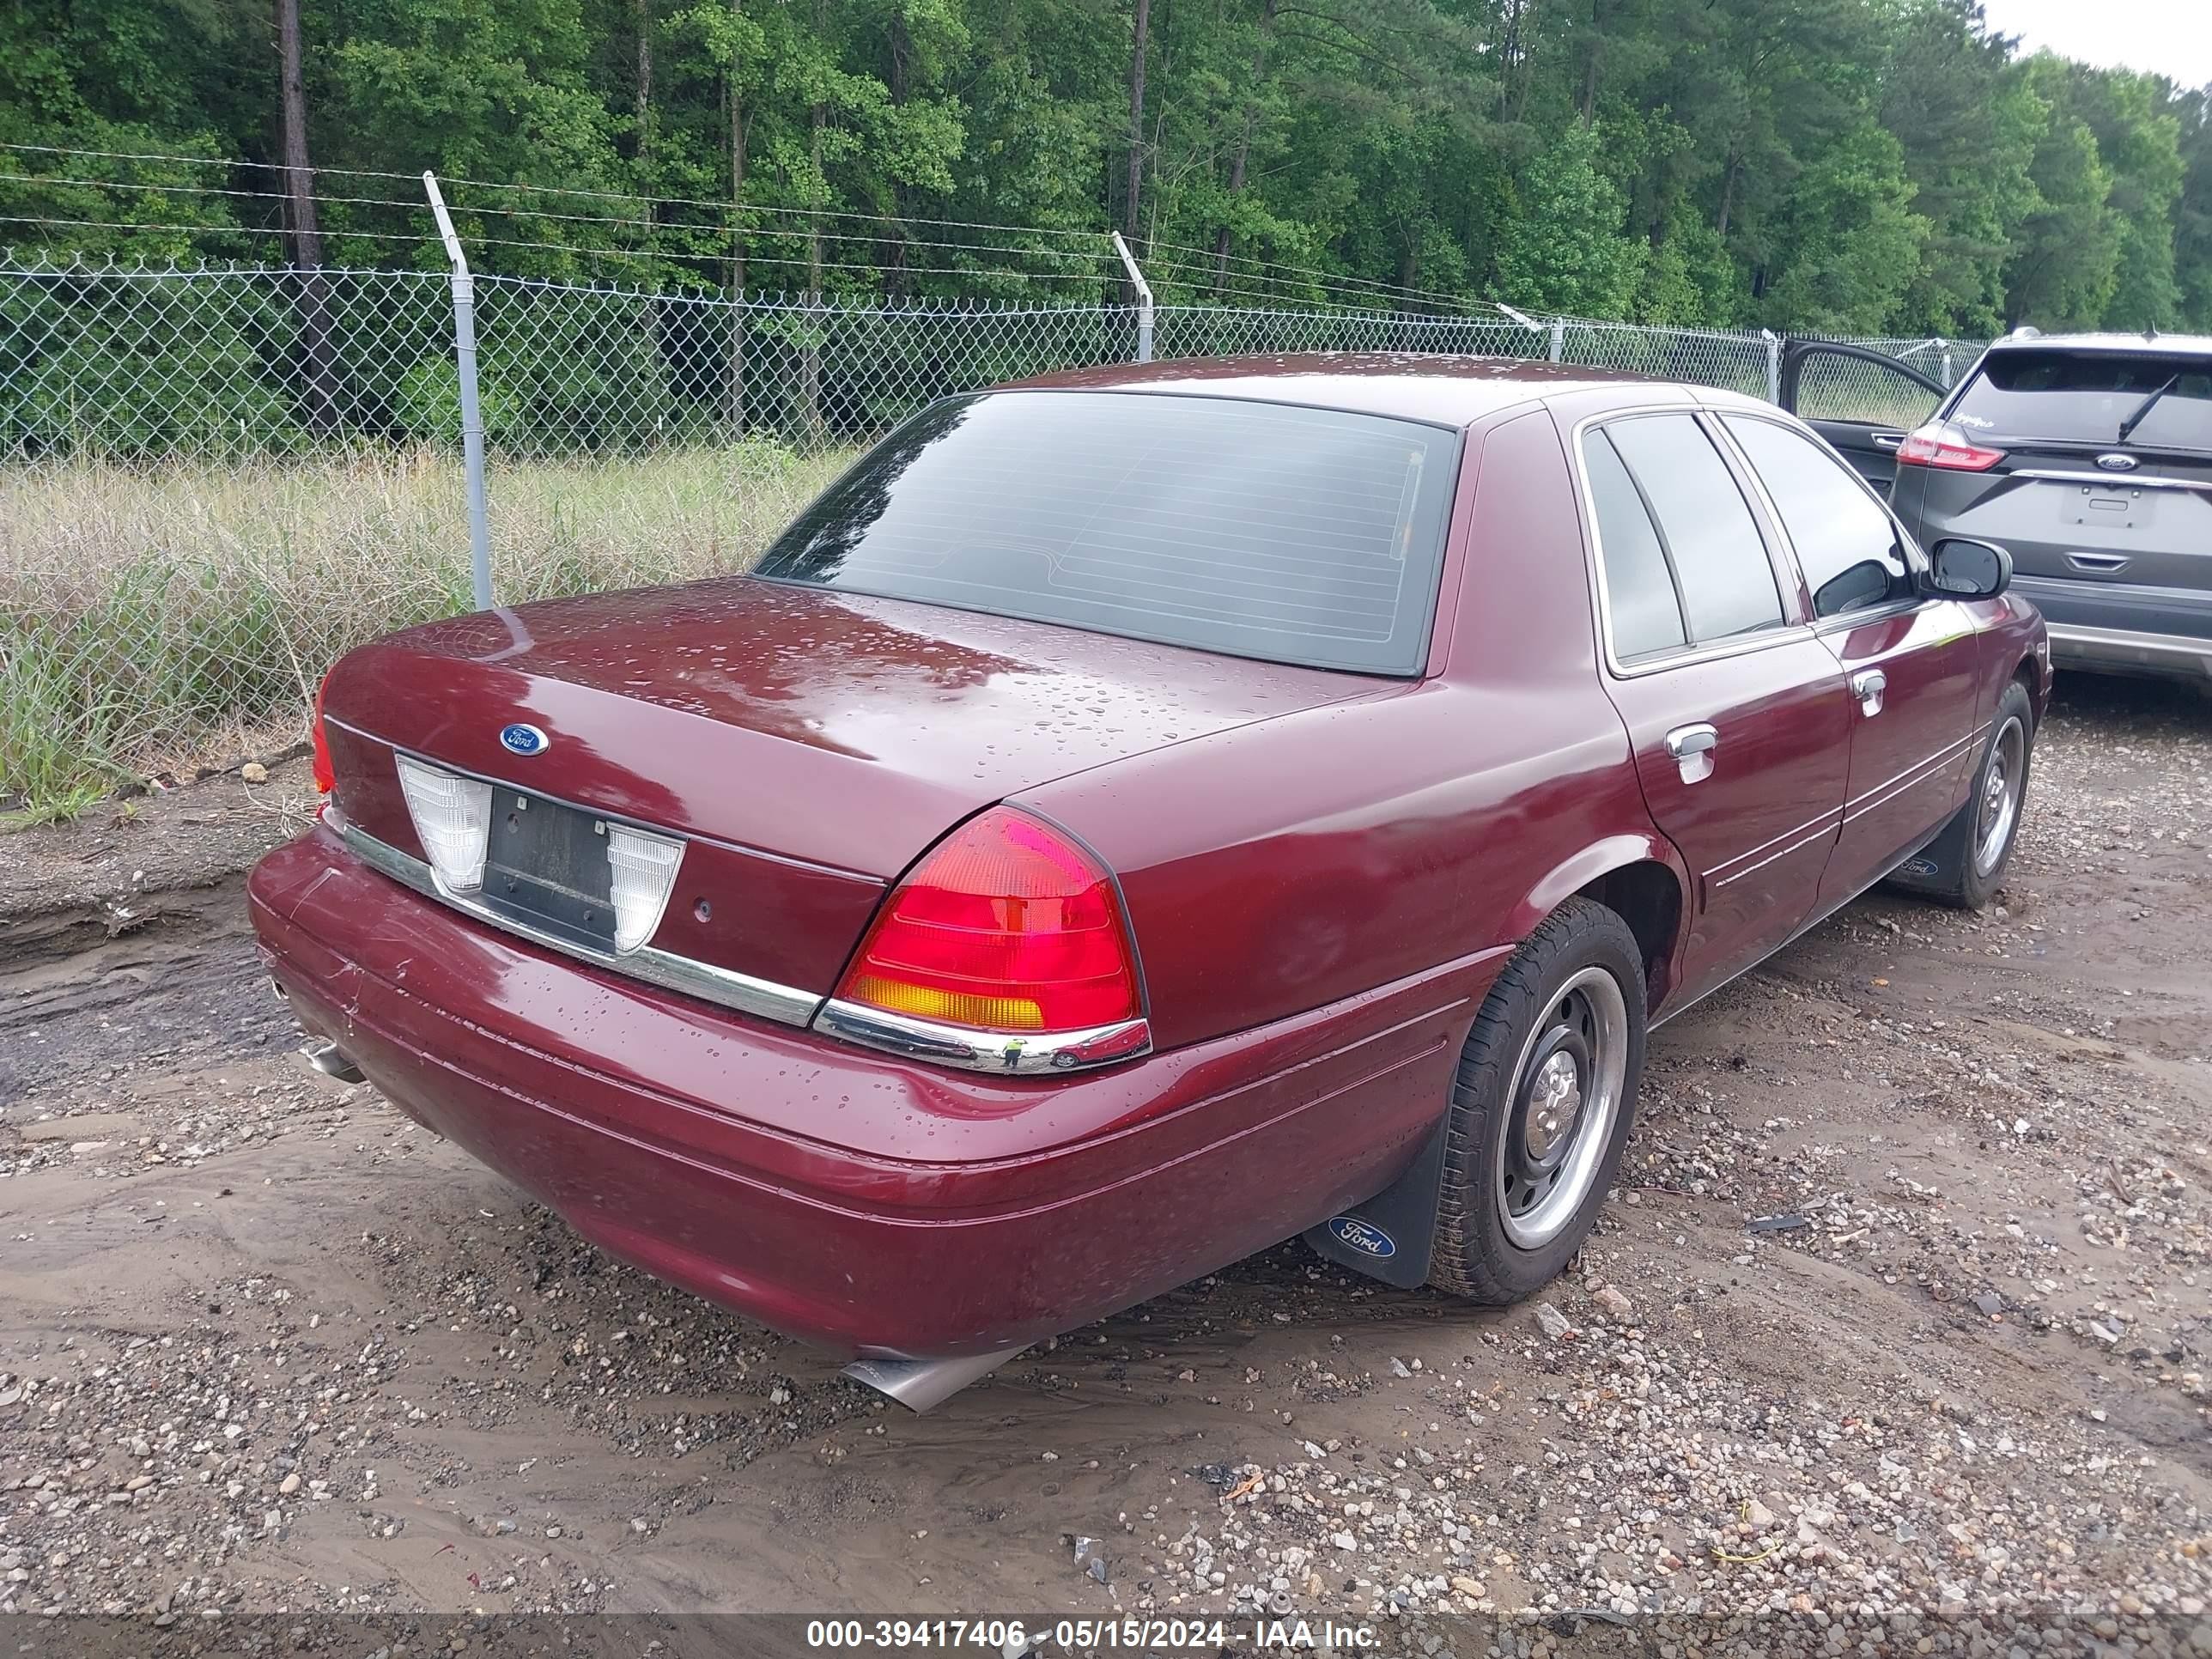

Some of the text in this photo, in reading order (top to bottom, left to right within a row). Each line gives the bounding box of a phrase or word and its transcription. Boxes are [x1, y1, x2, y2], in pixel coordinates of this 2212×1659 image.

[507, 728, 536, 748] Ford
[1900, 860, 1929, 874] Ford
[1340, 1222, 1382, 1253] Ford
